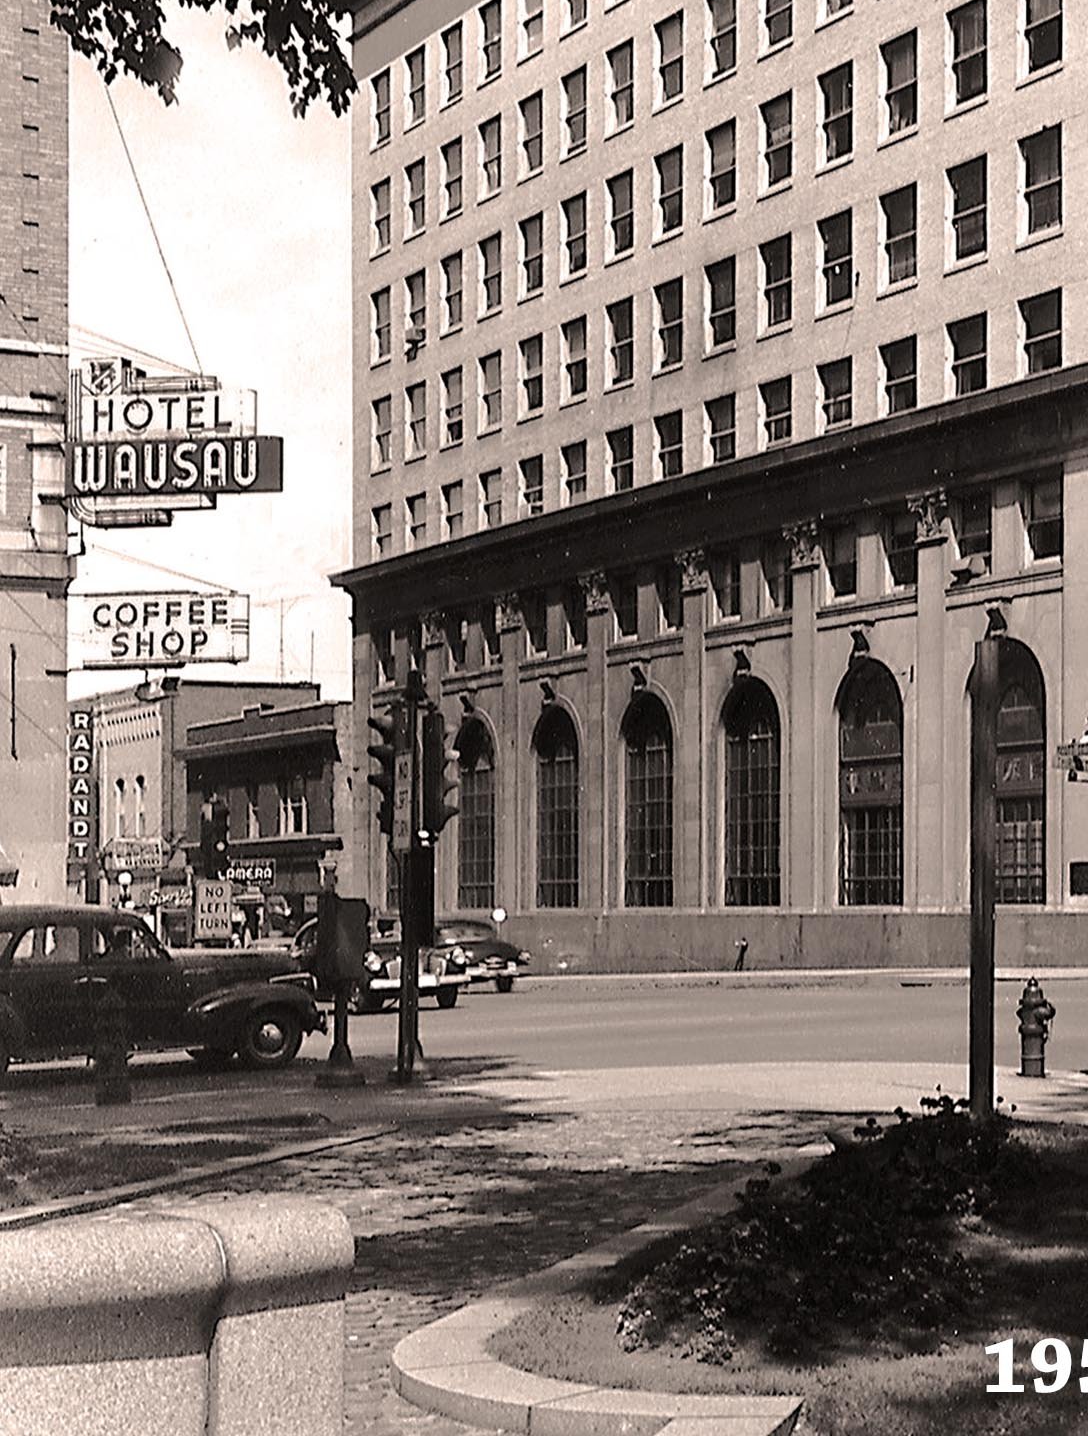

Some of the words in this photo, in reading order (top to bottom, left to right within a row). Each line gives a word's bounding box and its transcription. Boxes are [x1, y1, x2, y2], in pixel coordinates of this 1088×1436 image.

[92, 394, 233, 434] HOTEL
[73, 439, 258, 493] WAUSAU
[92, 599, 229, 628] COFFEE
[111, 630, 209, 658] SHOP
[73, 713, 91, 858] RADANDT
[205, 886, 224, 898] NO
[200, 902, 228, 914] LEFT
[200, 918, 229, 930] TURN
